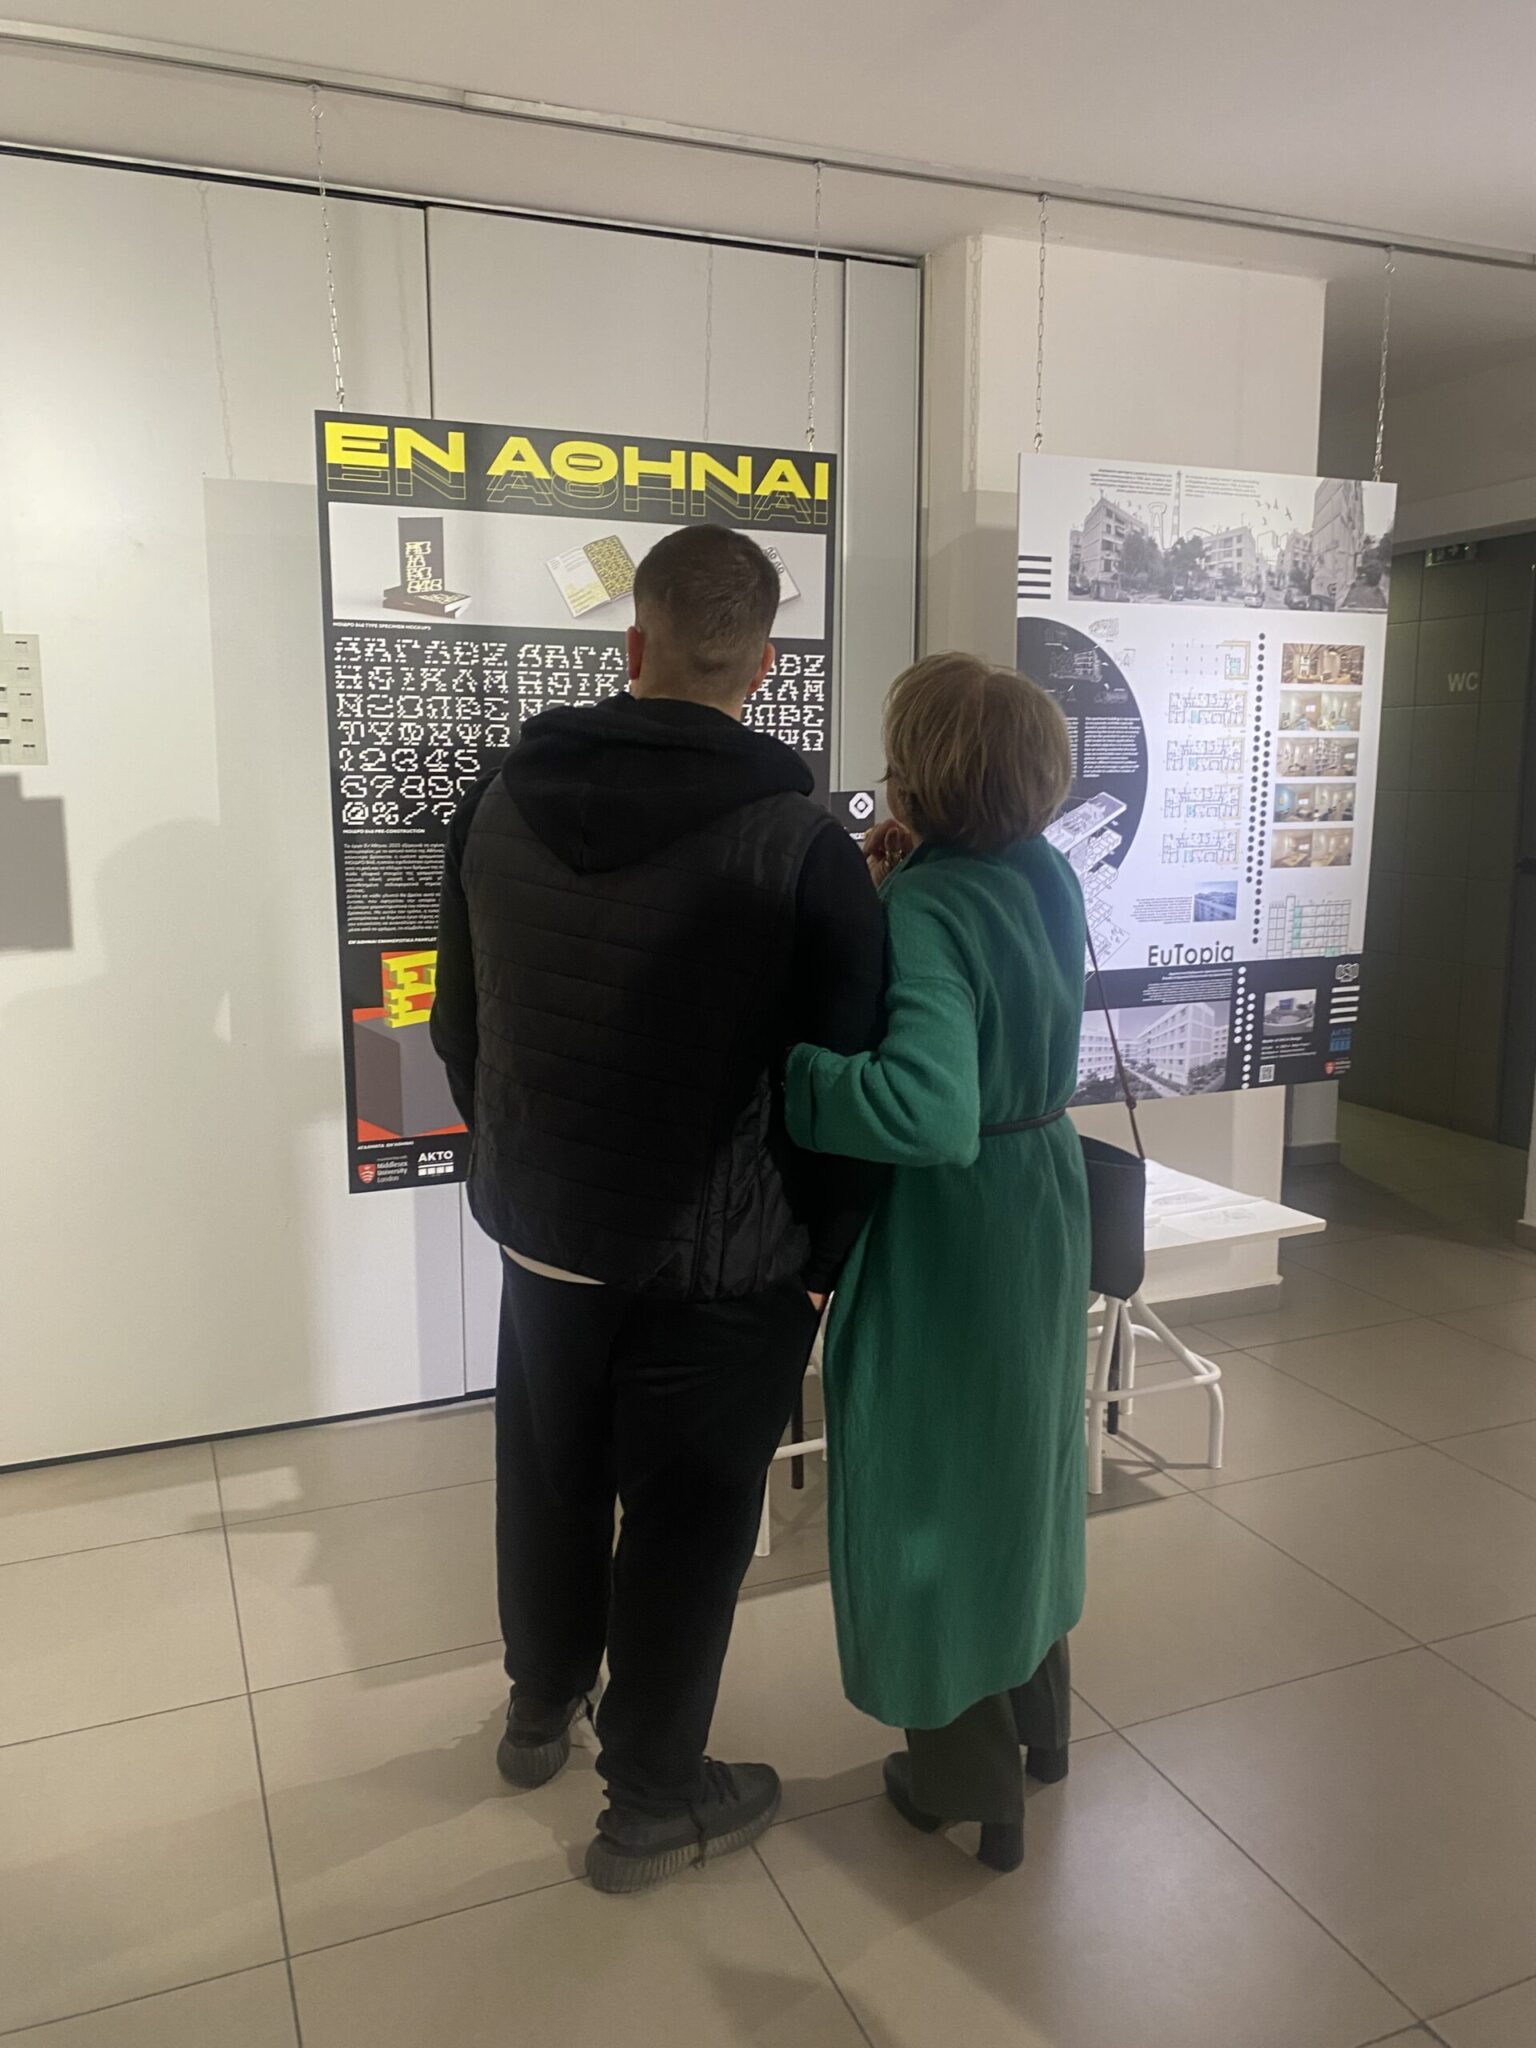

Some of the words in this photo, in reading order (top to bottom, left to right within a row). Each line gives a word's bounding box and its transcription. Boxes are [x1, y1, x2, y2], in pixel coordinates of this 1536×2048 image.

[325, 421, 466, 500] ΕΝ
[486, 436, 829, 526] ΑΘΗΝΑΙ
[1447, 672, 1479, 692] WC
[1148, 941, 1234, 966] EuTopia
[377, 1161, 408, 1169] Middlesex
[418, 1150, 454, 1163] AKTO
